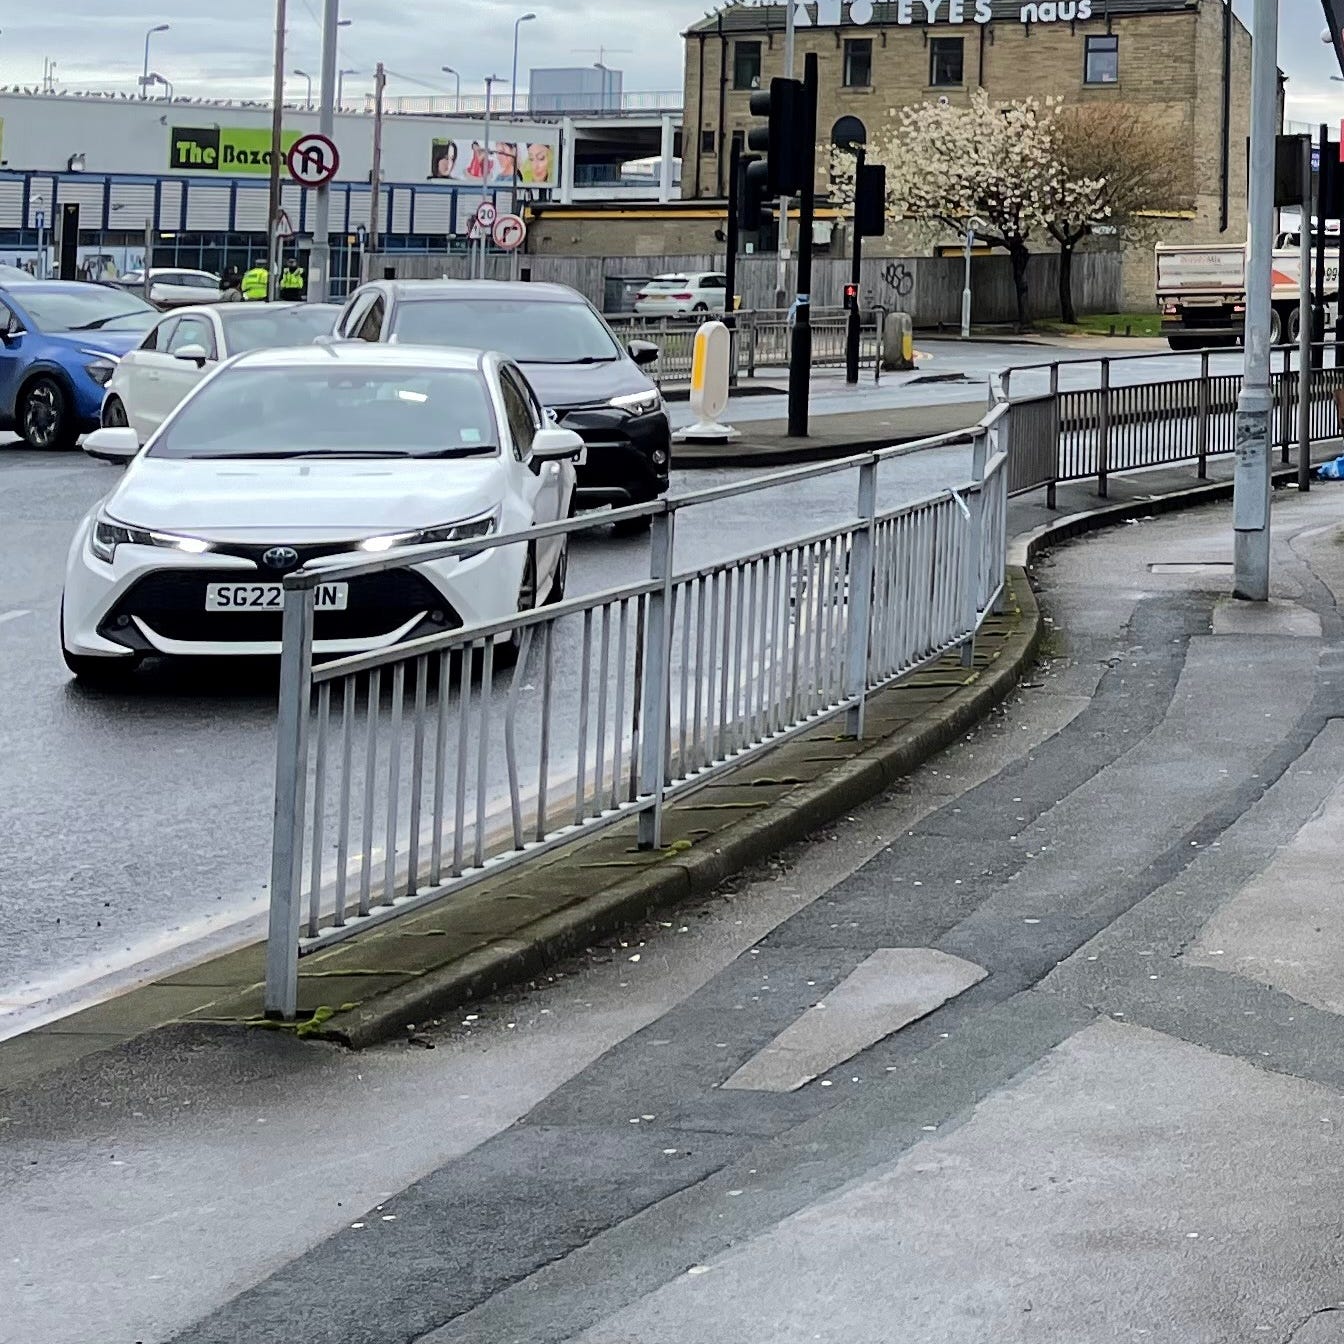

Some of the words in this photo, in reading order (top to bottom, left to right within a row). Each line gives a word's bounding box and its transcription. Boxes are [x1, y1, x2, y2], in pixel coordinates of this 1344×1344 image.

[176, 140, 217, 164] The
[480, 209, 494, 220] 20
[217, 586, 281, 607] SG22
